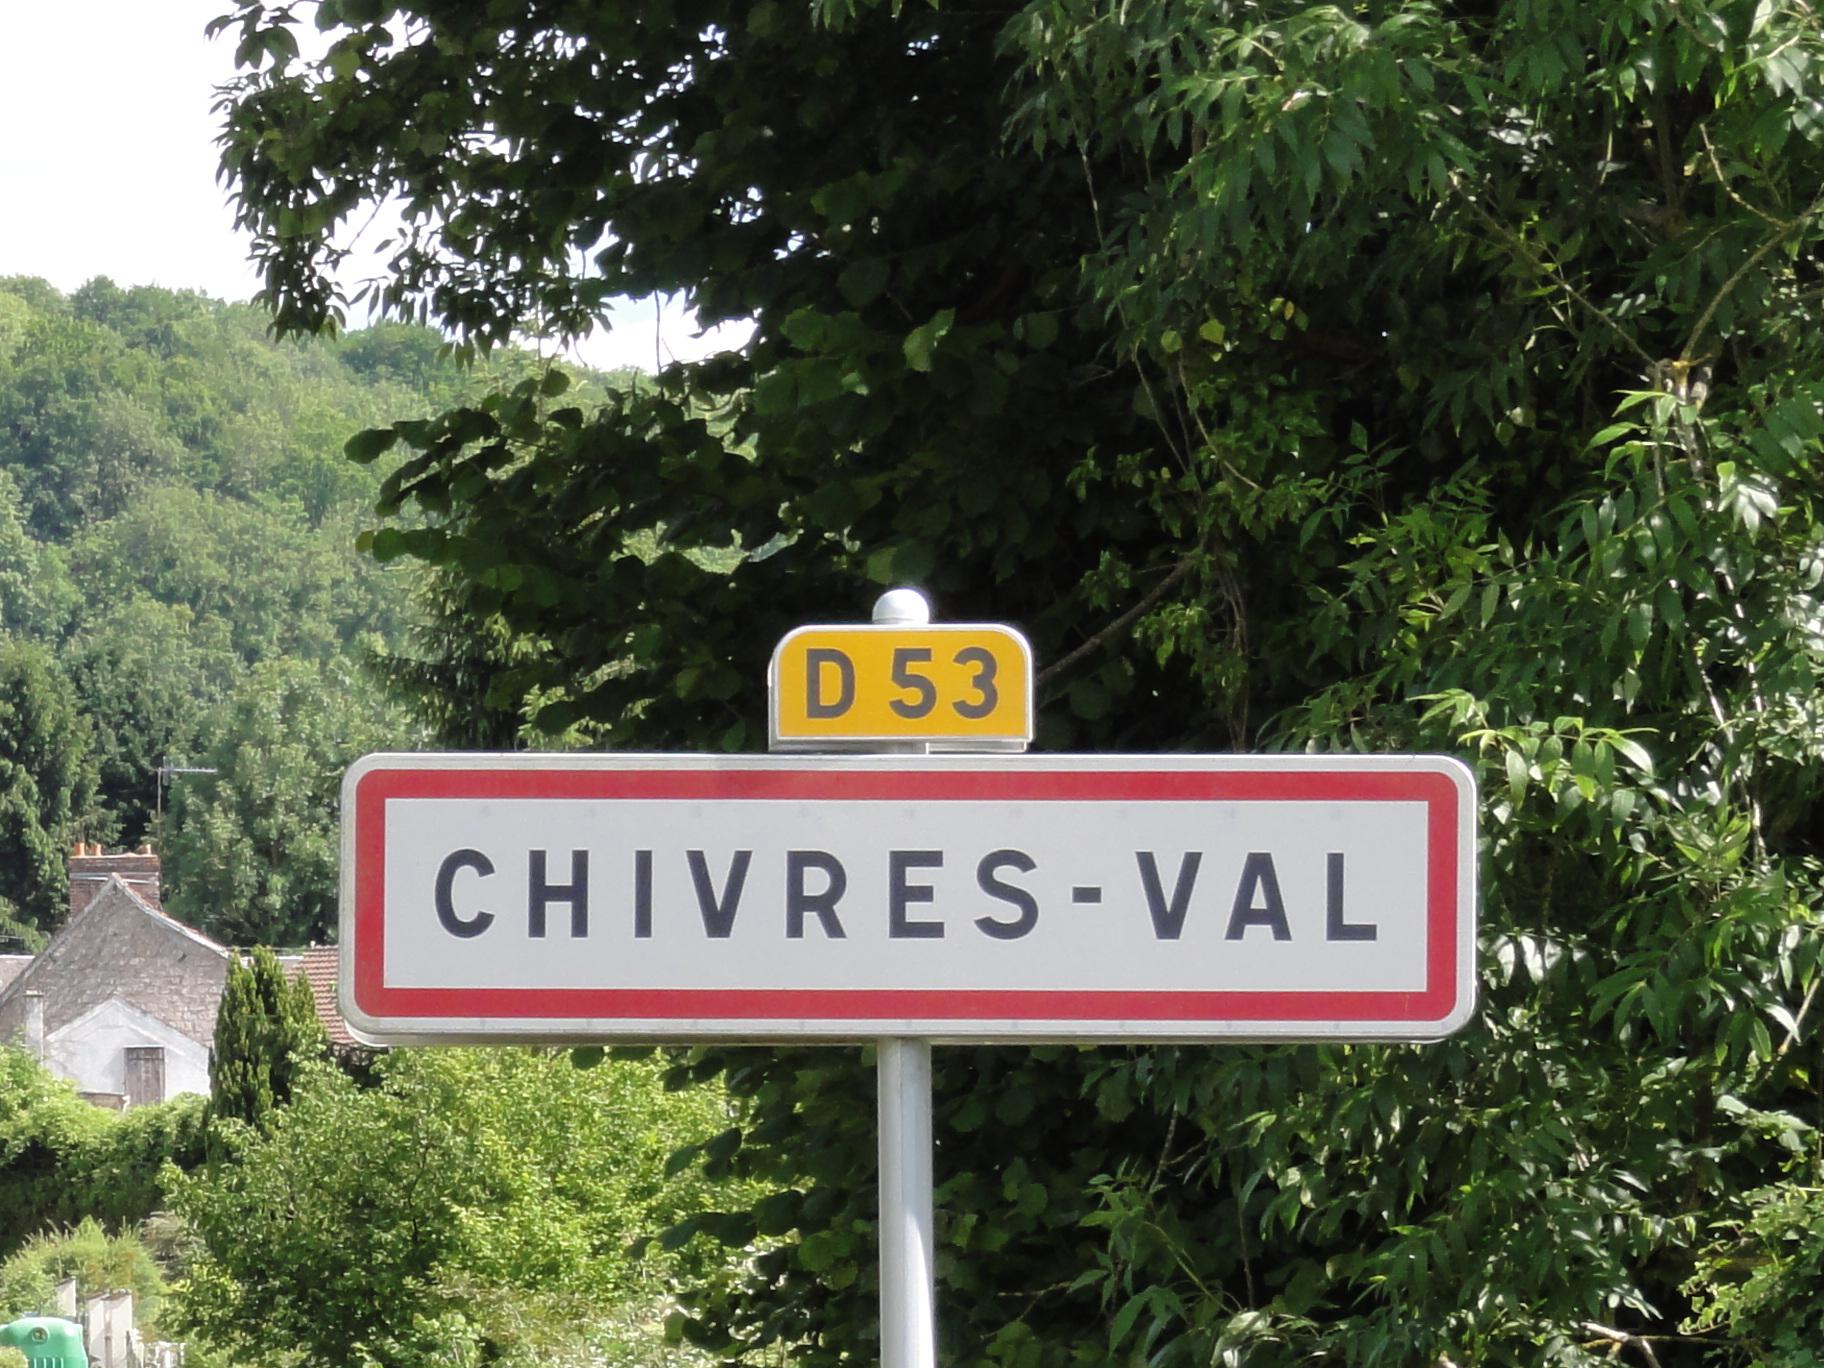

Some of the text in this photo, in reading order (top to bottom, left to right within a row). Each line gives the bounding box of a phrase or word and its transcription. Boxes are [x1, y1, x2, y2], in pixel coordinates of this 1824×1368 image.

[805, 646, 999, 719] D 53
[434, 847, 1379, 942] CHIVRES-VAL
